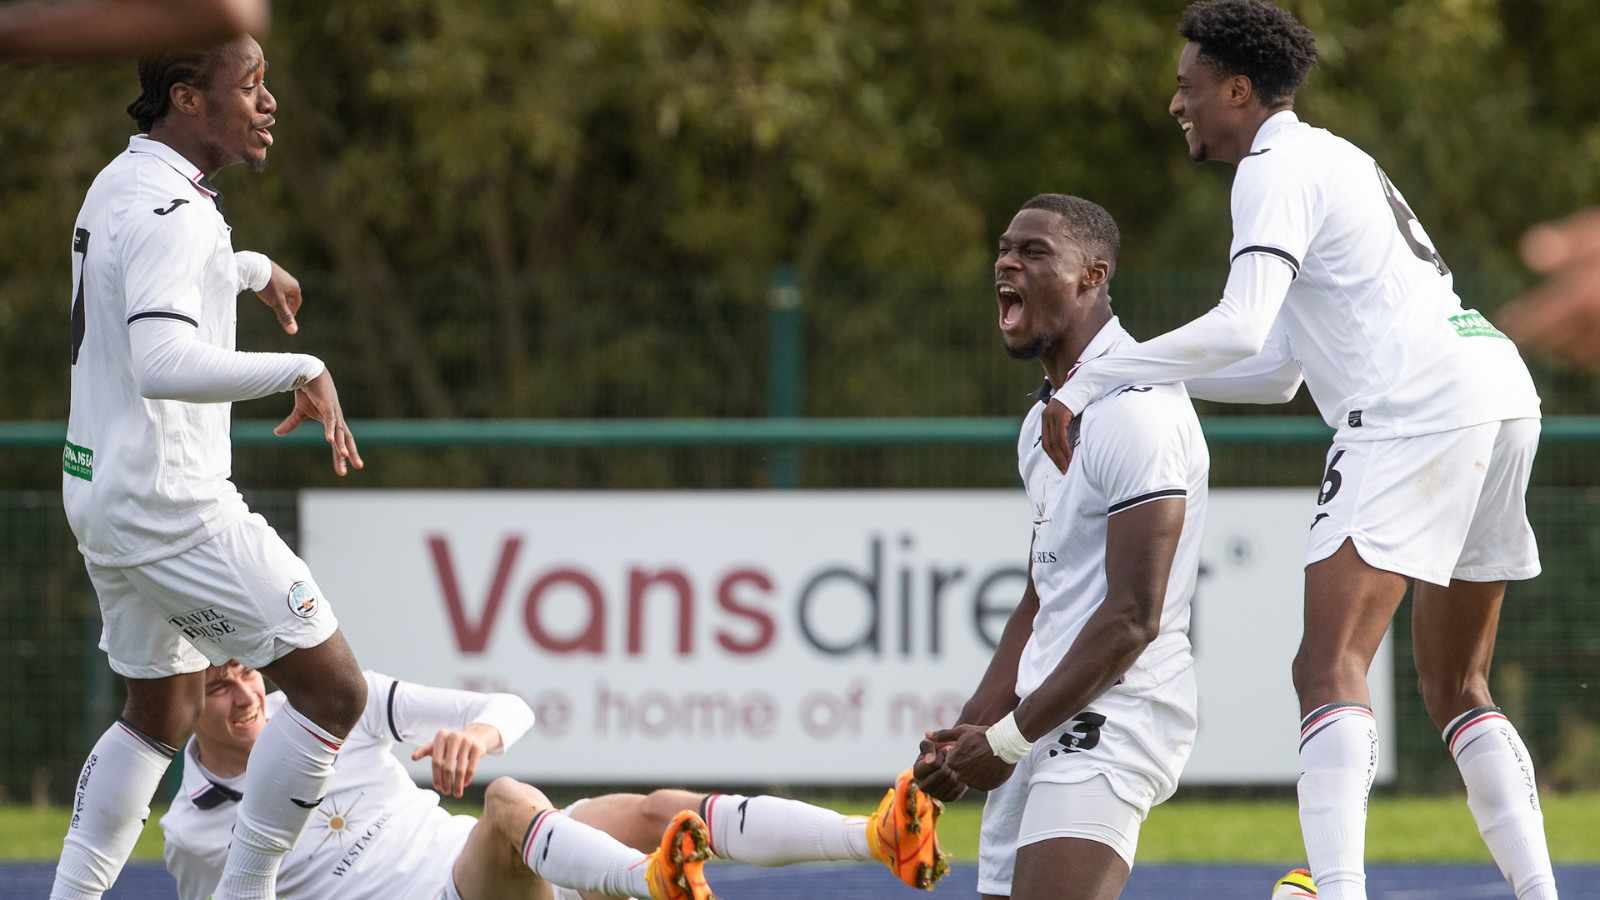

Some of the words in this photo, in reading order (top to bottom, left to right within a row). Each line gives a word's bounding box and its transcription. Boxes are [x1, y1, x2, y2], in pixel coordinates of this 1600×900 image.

[1317, 449, 1346, 506] 6
[168, 608, 225, 627] TRAVEL
[182, 619, 236, 640] HOUSE
[597, 676, 780, 741] home
[799, 676, 870, 741] of
[1058, 711, 1107, 750] 3
